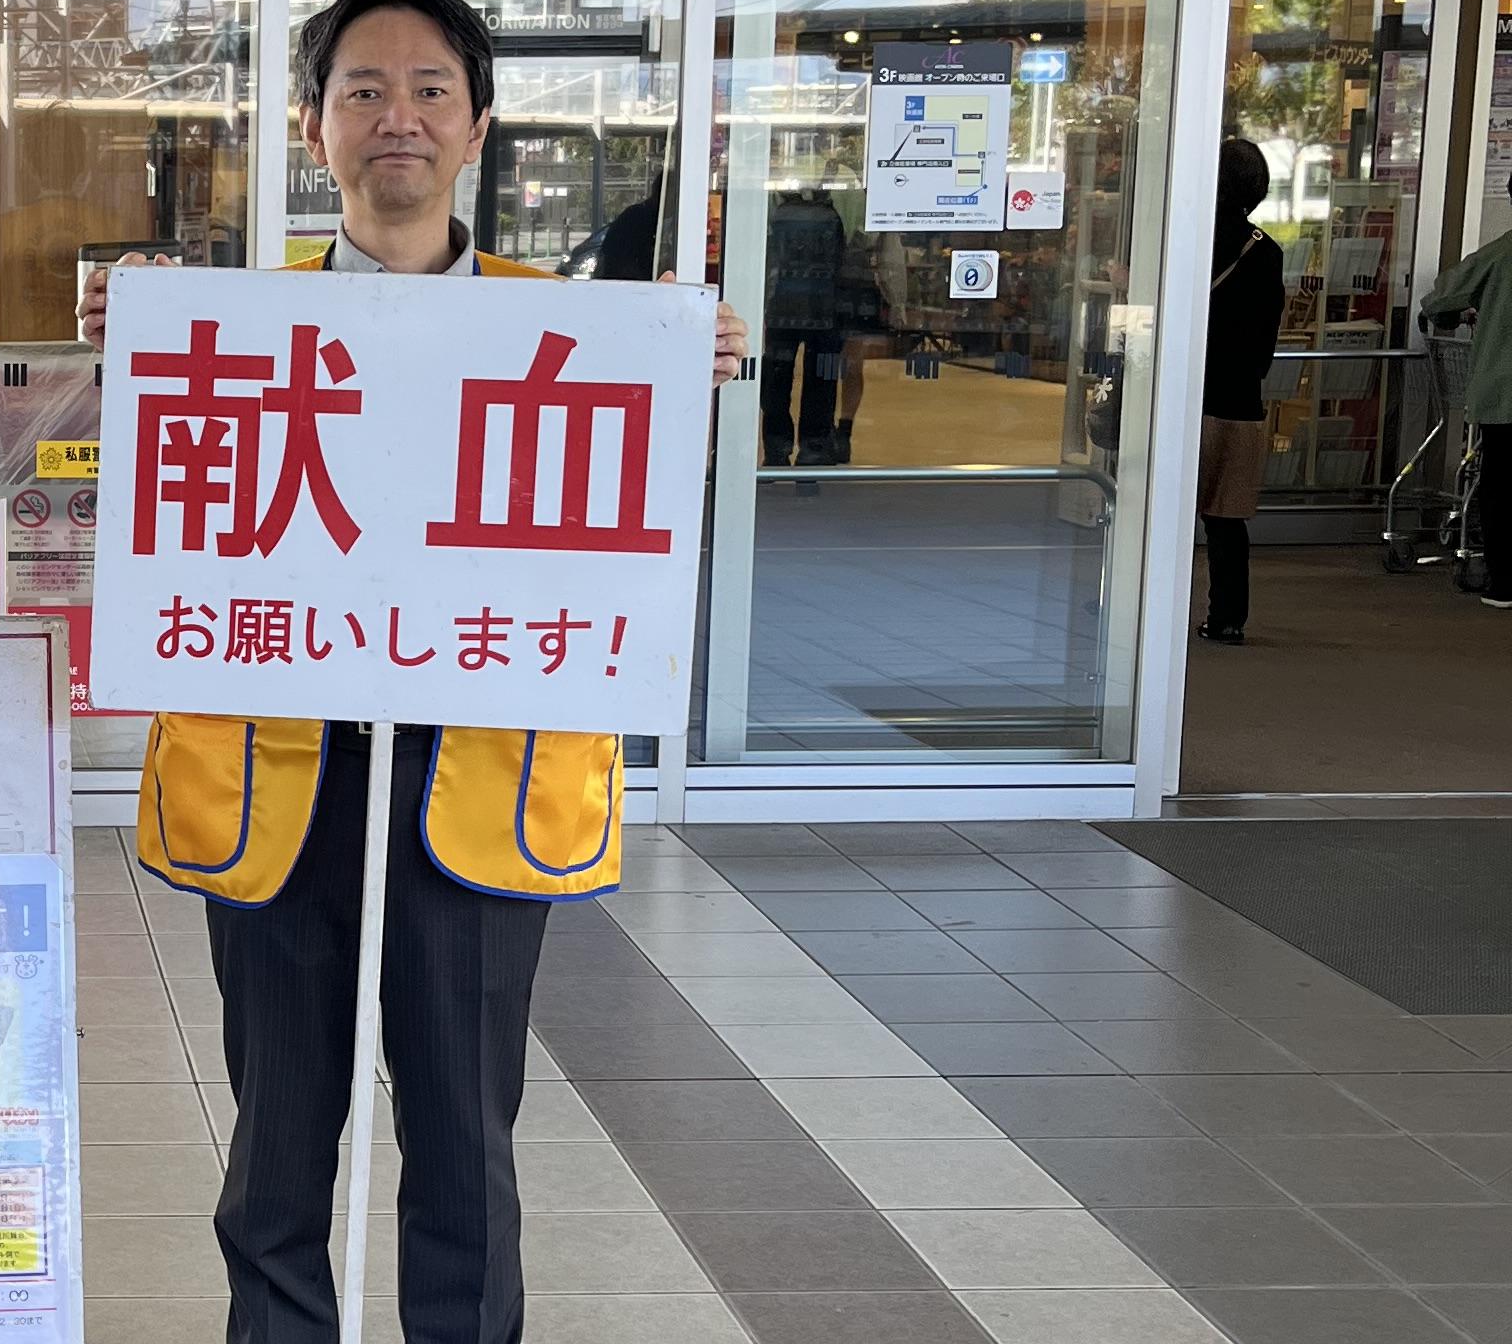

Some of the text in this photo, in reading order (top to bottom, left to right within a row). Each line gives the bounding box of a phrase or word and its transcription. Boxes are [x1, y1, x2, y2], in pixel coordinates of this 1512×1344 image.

[879, 67, 897, 83] 3F
[130, 319, 672, 559] 献血
[155, 594, 628, 678] お願いします！
